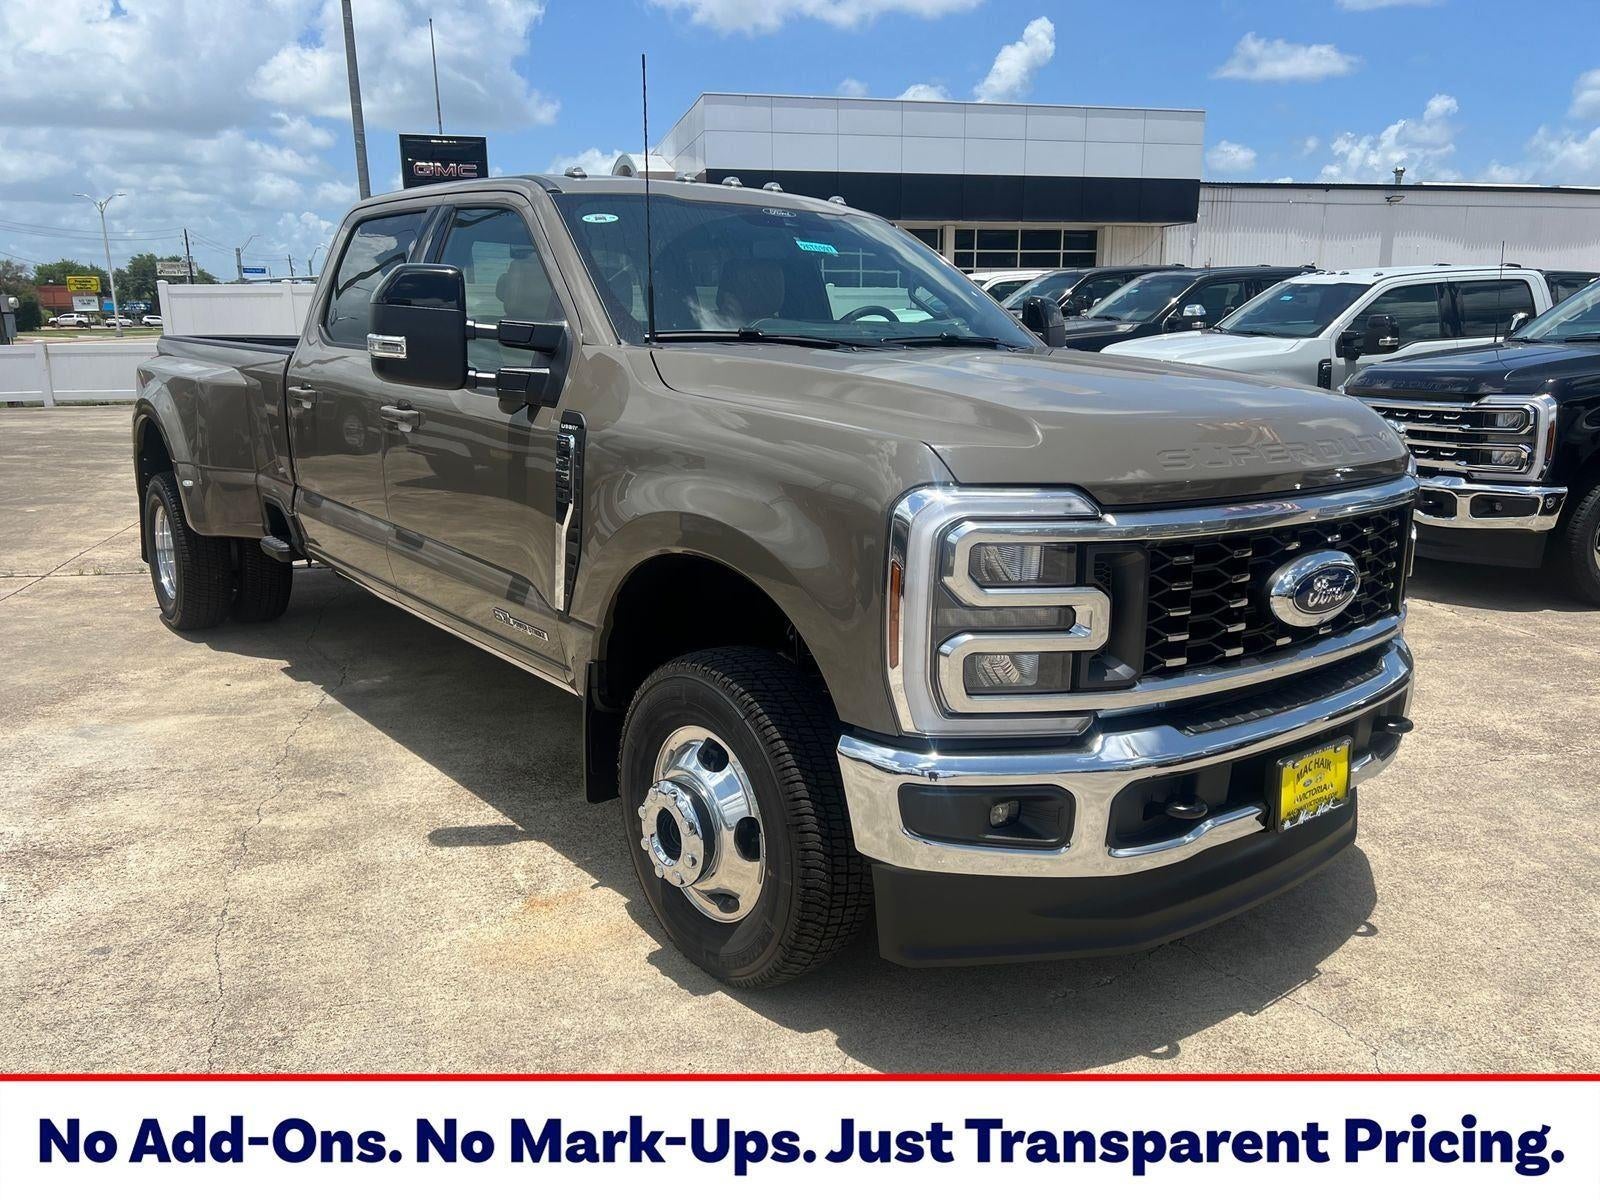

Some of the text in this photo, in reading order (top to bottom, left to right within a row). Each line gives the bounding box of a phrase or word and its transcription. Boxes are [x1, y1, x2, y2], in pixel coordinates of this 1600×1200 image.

[413, 162, 478, 178] GMC
[1157, 429, 1394, 471] SUPER DUTY
[1307, 573, 1350, 608] Ford
